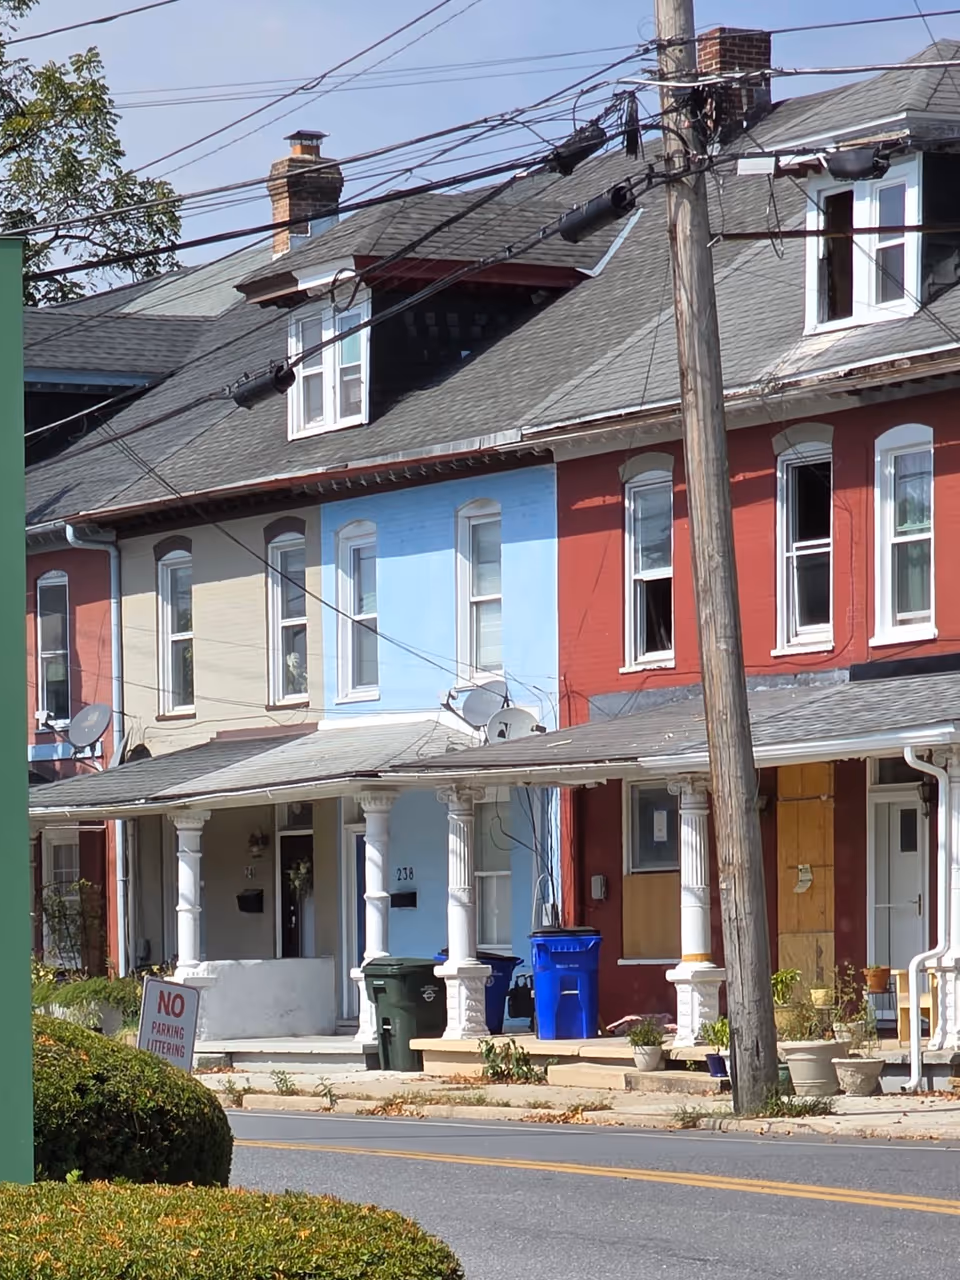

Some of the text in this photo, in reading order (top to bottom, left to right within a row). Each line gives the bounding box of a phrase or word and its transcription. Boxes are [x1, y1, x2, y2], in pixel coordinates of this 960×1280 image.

[396, 866, 415, 881] 238
[156, 989, 186, 1019] NO
[150, 1020, 185, 1041] PARKING
[146, 1037, 186, 1059] LITTERING
